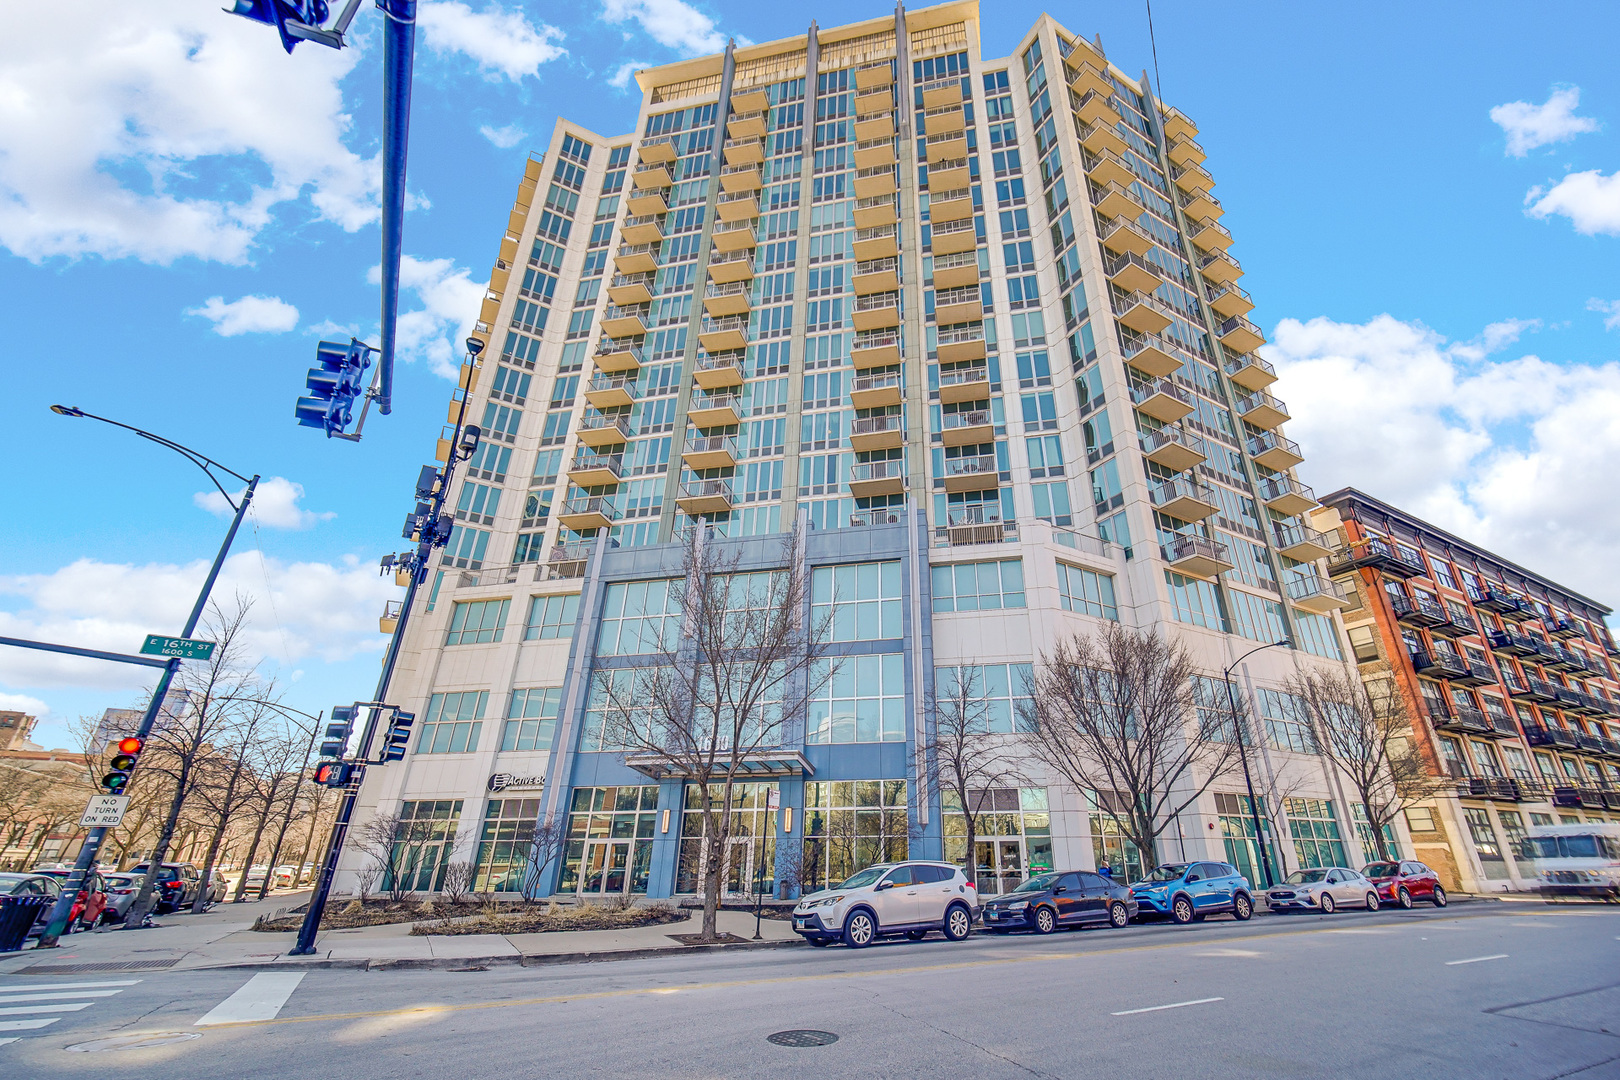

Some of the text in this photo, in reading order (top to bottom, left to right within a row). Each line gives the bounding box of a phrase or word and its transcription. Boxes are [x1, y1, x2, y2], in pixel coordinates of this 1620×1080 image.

[163, 639, 193, 648] 16TH
[94, 806, 119, 814] TURN
[84, 815, 119, 823] ON RED
